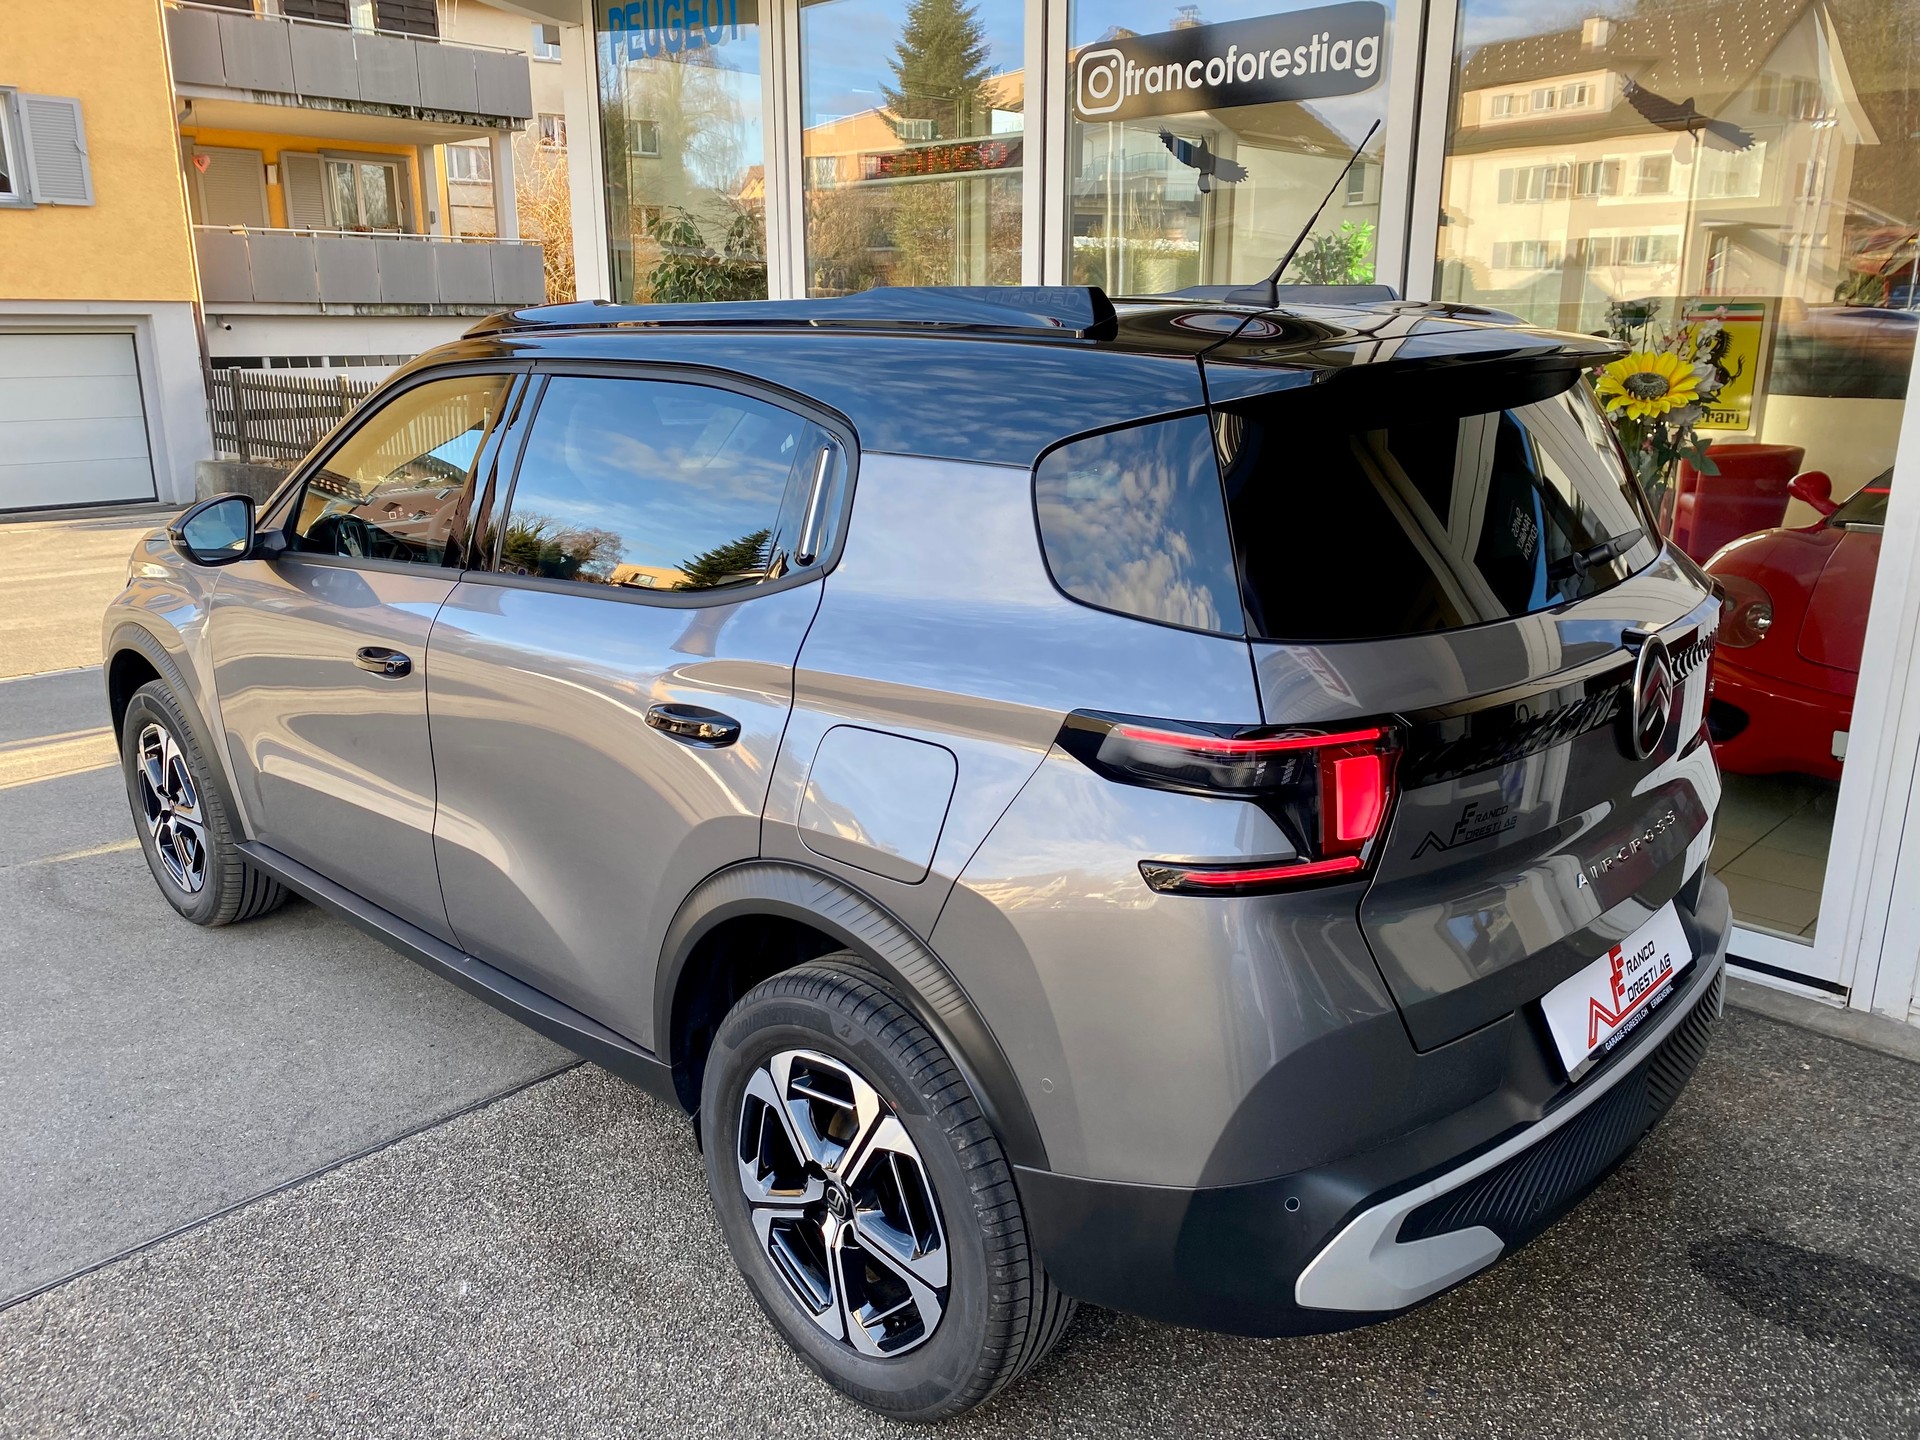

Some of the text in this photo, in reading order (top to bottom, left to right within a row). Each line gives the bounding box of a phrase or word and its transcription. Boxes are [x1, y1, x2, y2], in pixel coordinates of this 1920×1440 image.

[1125, 31, 1380, 96] francoforestiag
[1576, 810, 1676, 889] AIRCROSS
[1659, 952, 1671, 975] AG
